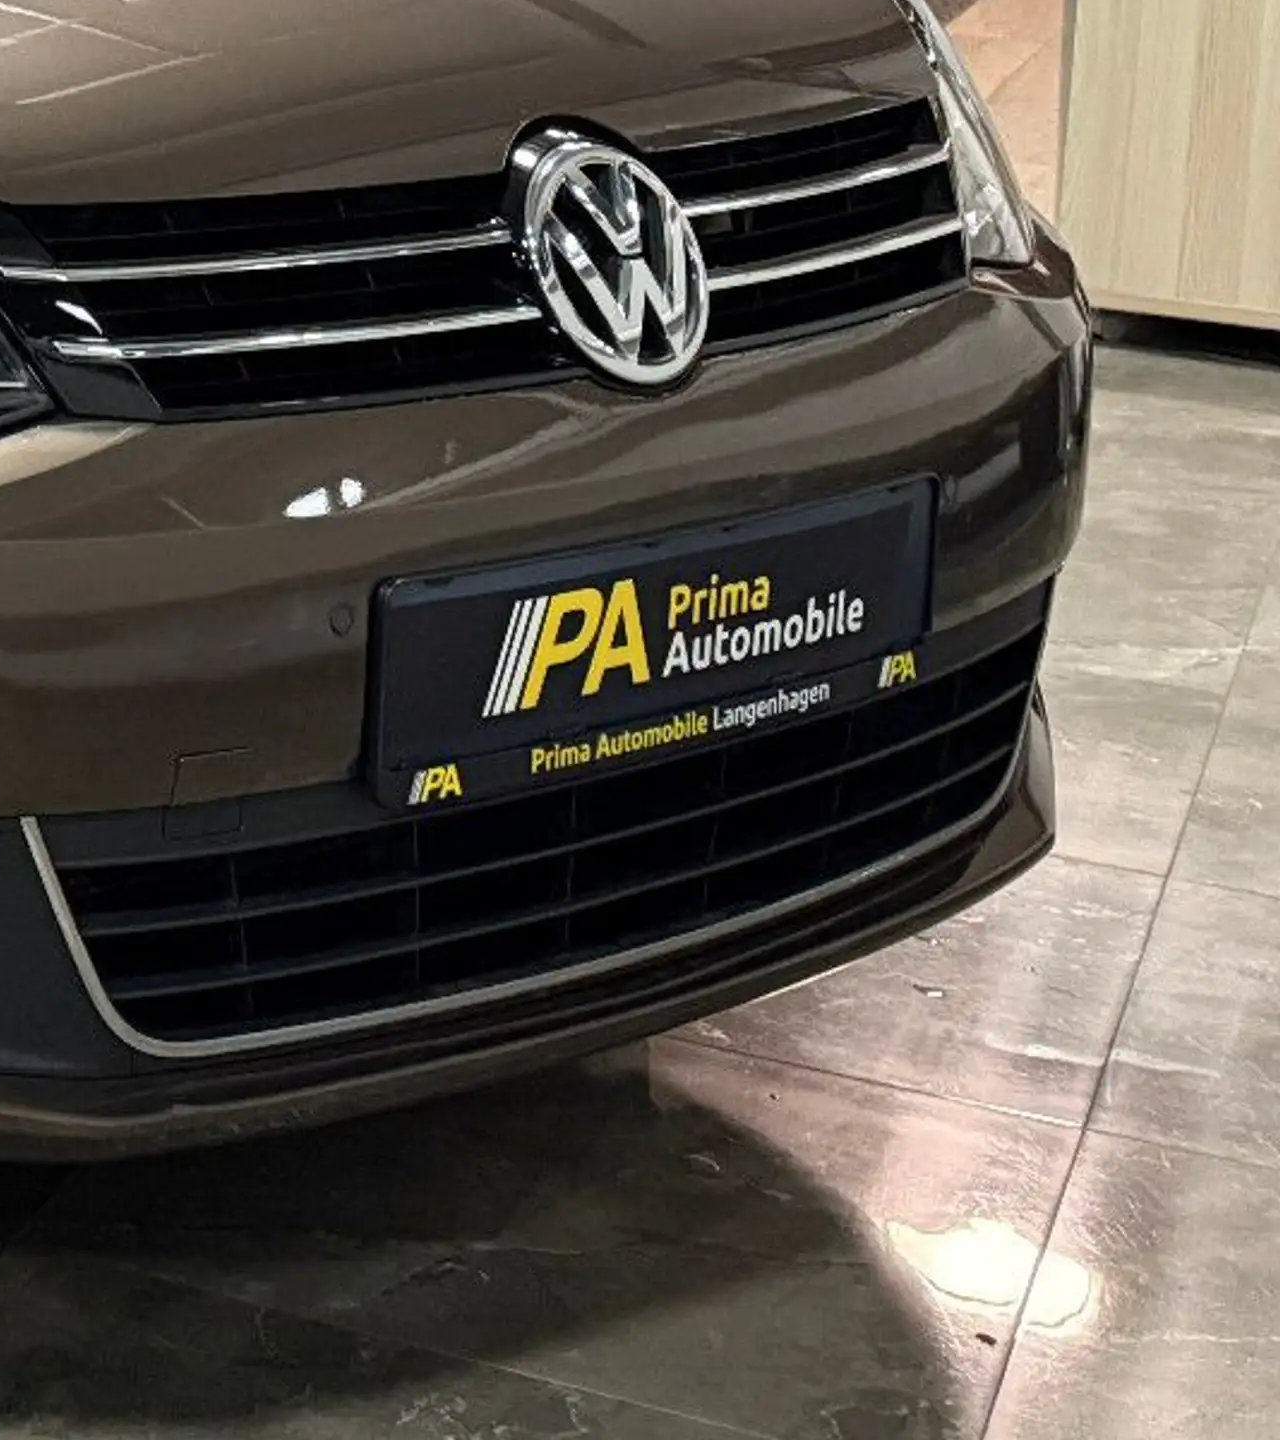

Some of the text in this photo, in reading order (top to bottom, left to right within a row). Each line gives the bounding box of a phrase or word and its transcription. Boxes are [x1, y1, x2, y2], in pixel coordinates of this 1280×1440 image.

[662, 589, 865, 679] Automobile
[667, 573, 772, 630] Prima
[530, 681, 832, 775] Prima Automobile Langenhagen
